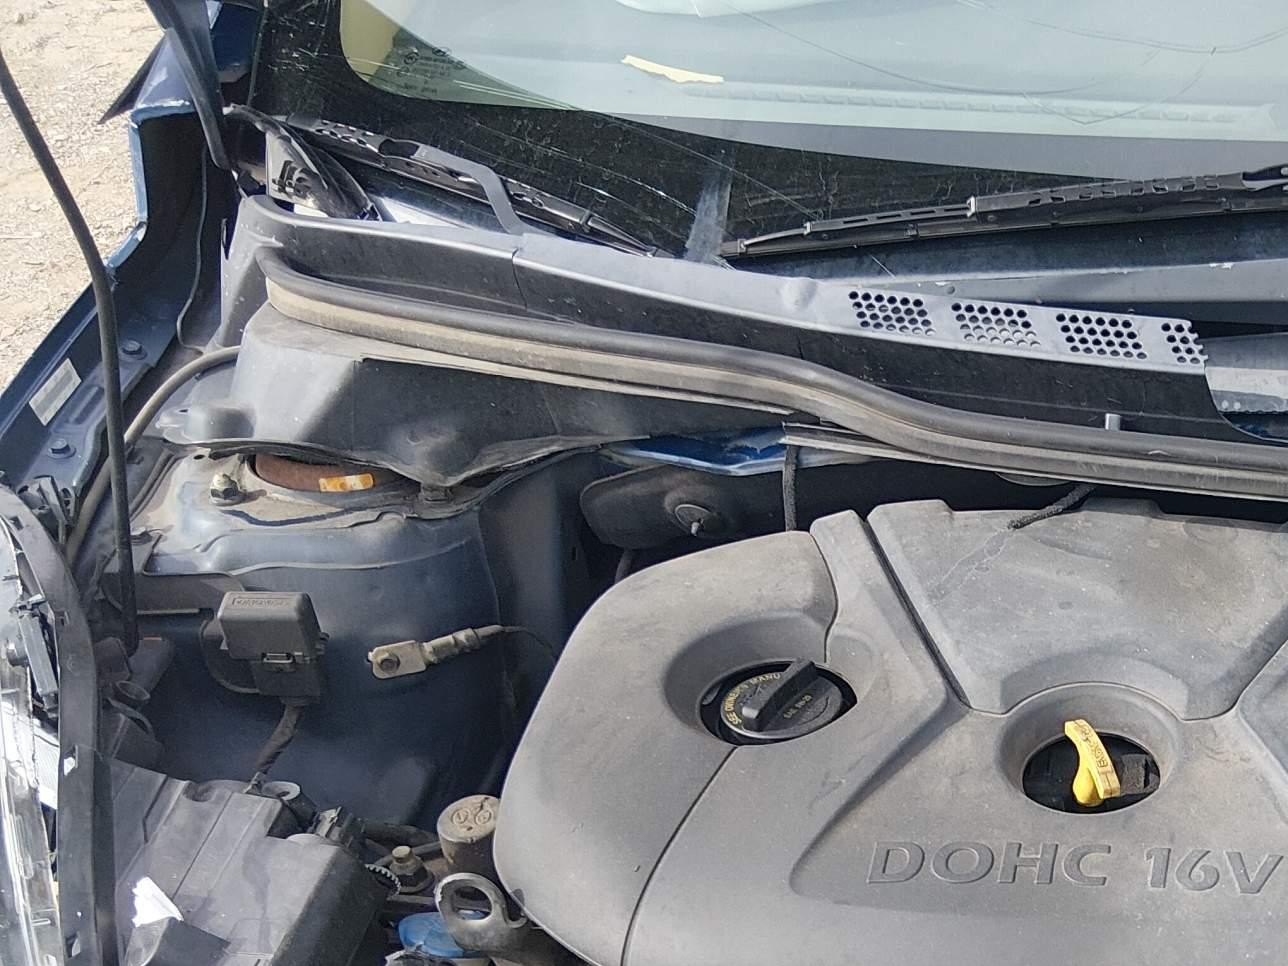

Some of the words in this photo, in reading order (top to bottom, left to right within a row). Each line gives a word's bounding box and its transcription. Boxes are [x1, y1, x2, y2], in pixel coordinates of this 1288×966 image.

[726, 711, 742, 725] SEE
[866, 840, 1112, 886] DOHC
[1144, 846, 1285, 896] 16V
